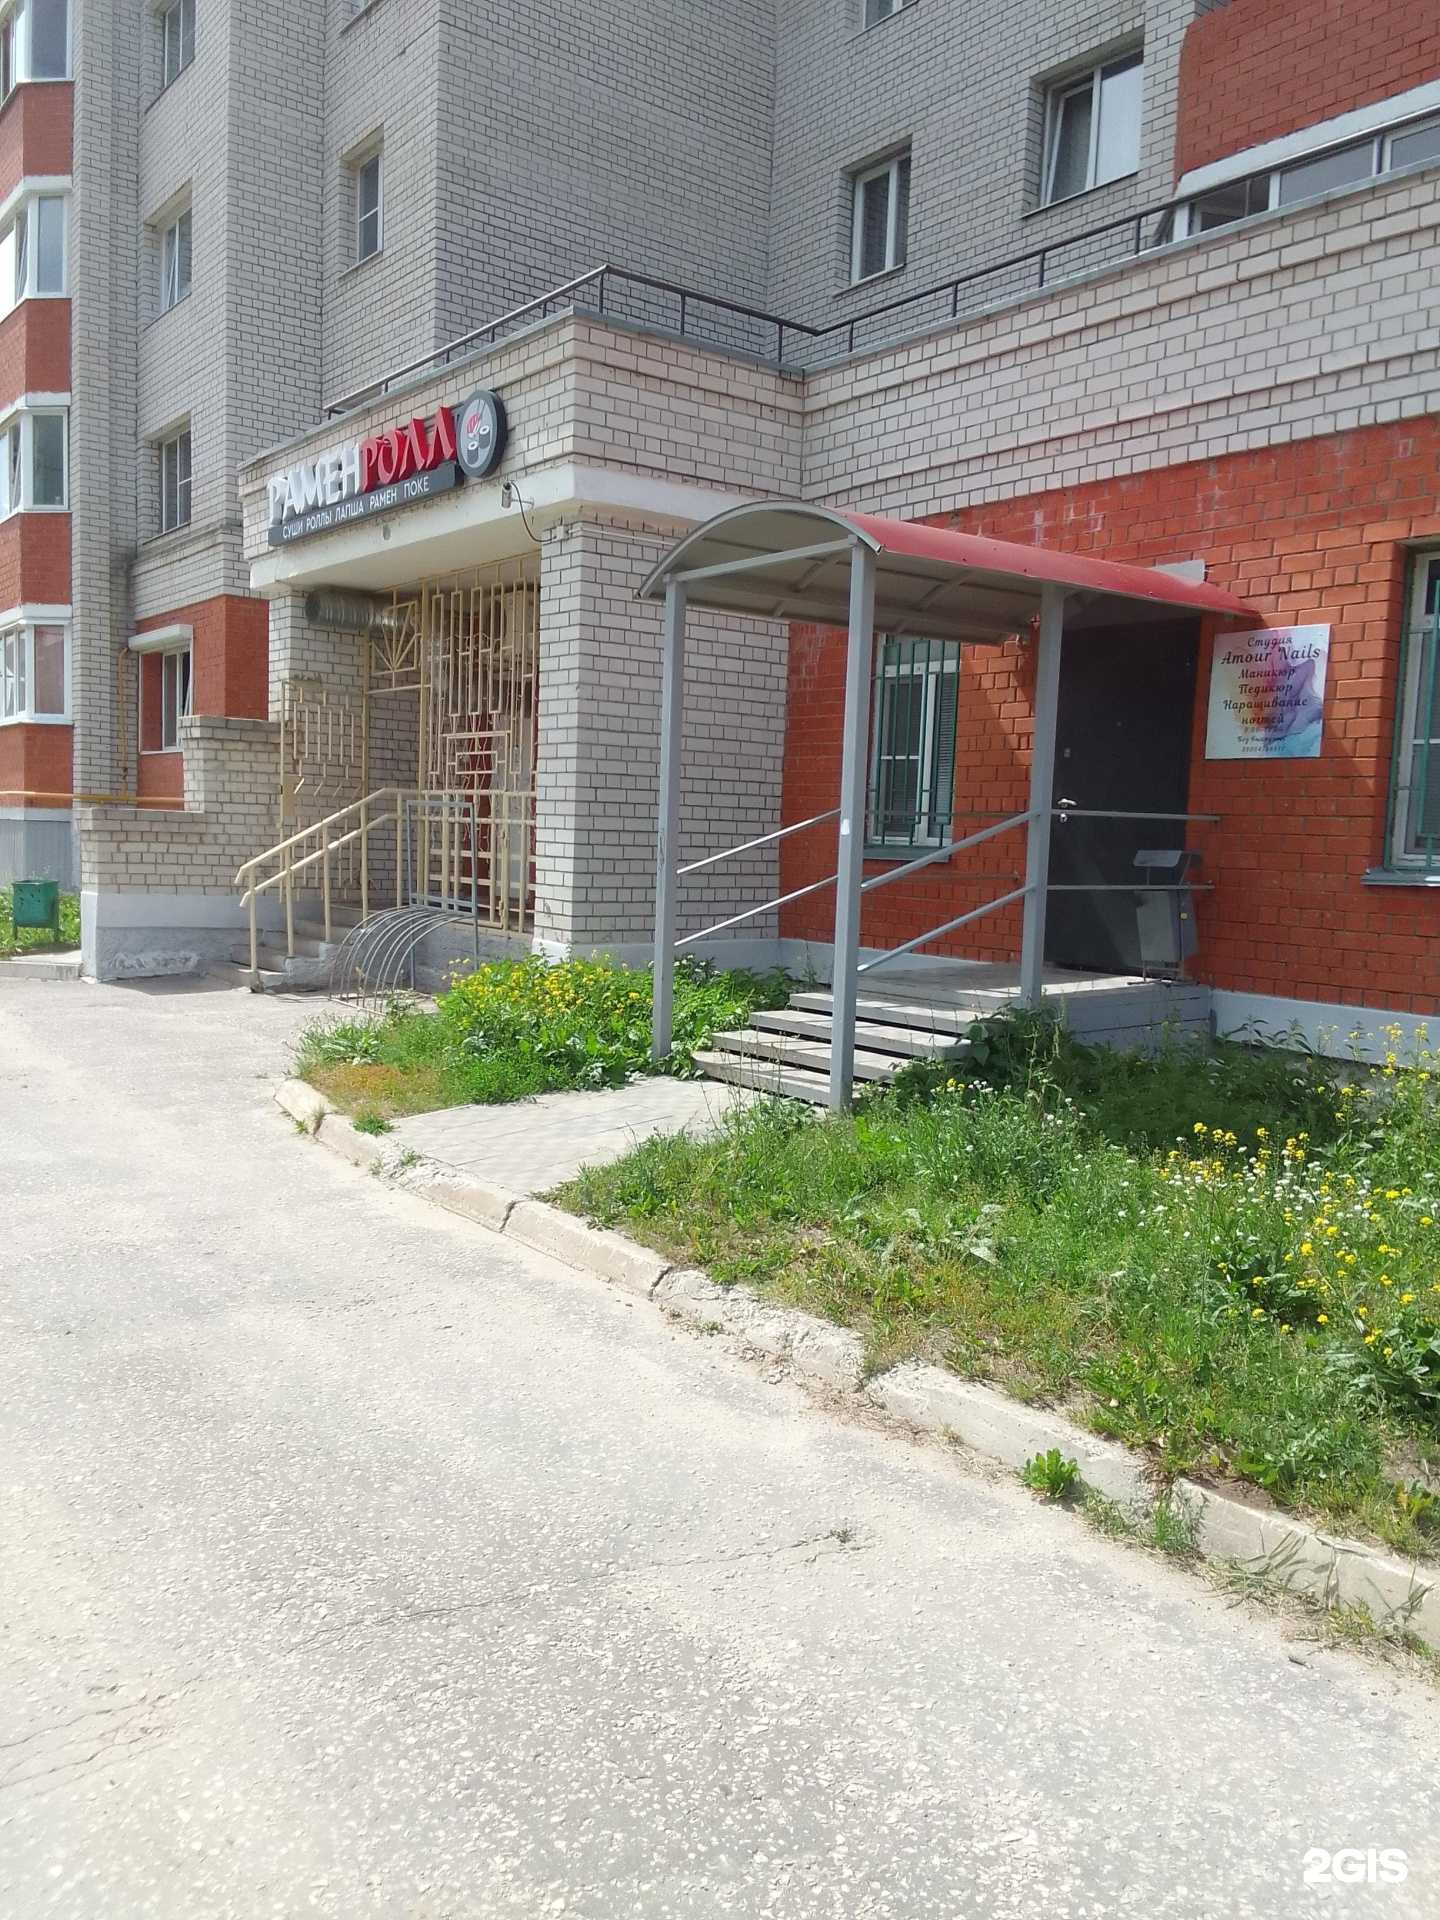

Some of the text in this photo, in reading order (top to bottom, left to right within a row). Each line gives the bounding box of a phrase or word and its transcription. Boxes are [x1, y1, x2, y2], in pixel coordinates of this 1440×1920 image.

[282, 476, 430, 539] СУШИ РОЛЛЫ ЛАПША РАМЕН ПОКЕ
[1247, 635, 1293, 649] Студия
[1220, 643, 1321, 665] Amour Nails
[1238, 666, 1296, 680] Маникюр
[1238, 684, 1293, 697] Педикюр
